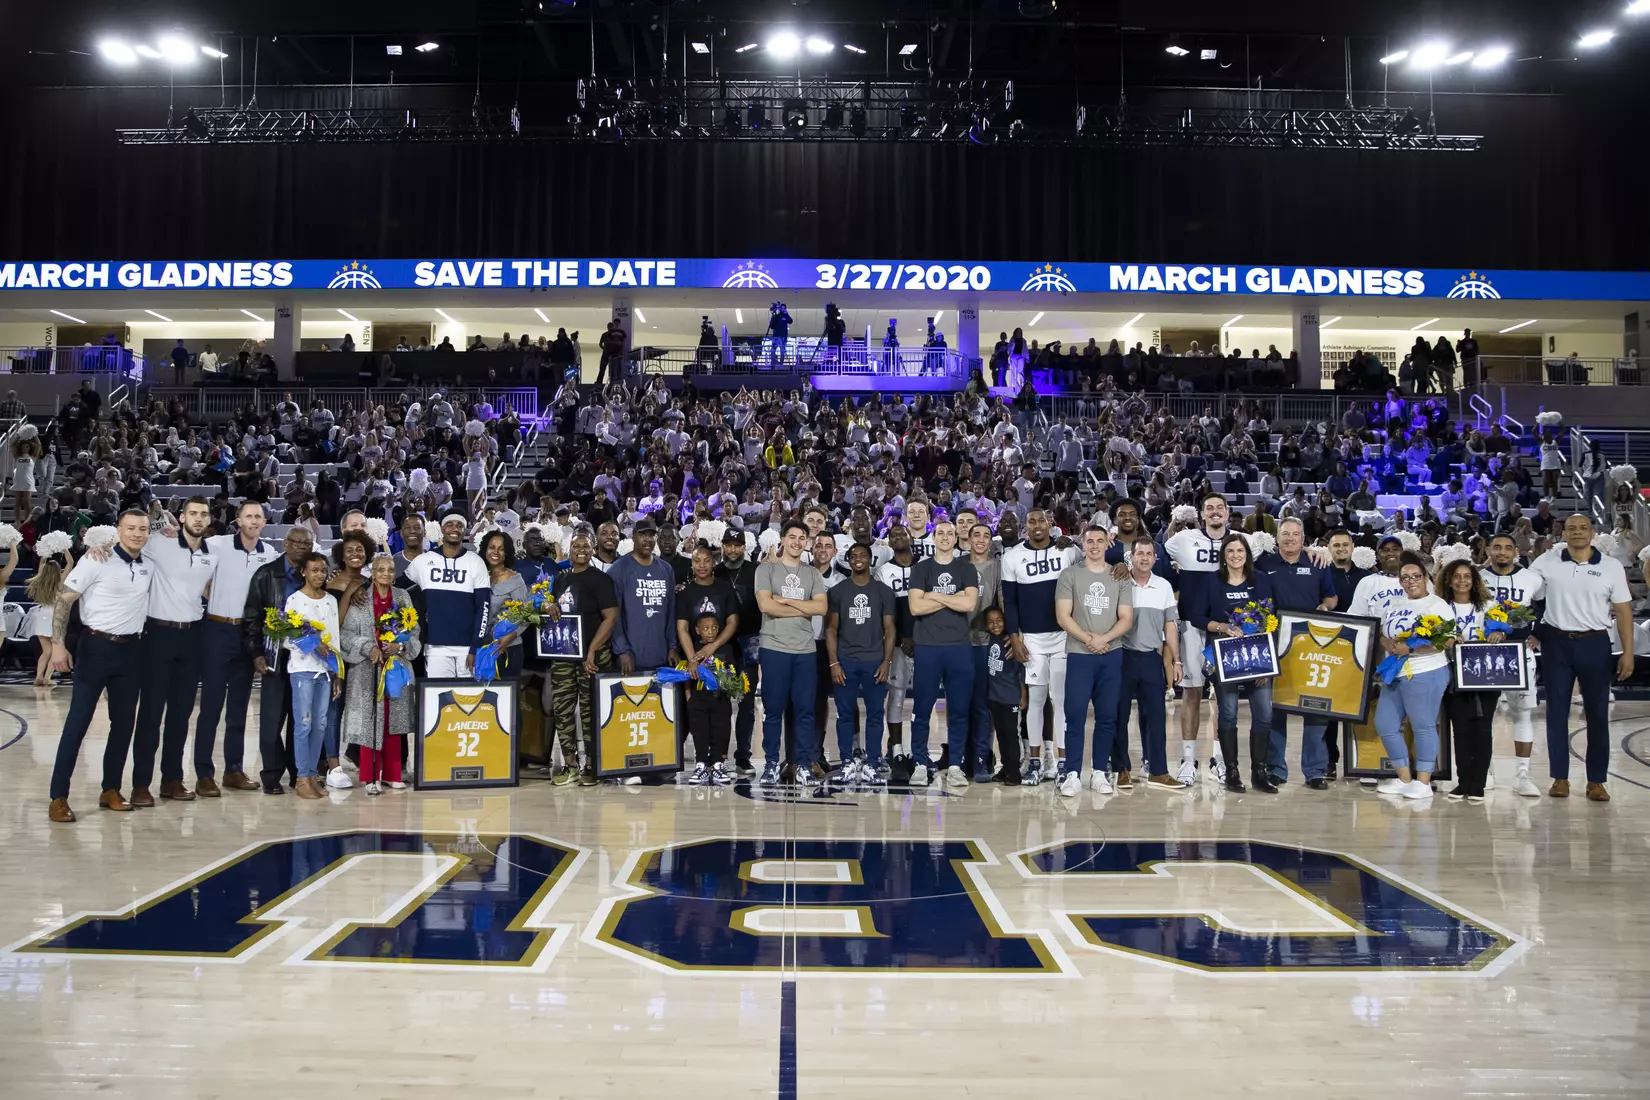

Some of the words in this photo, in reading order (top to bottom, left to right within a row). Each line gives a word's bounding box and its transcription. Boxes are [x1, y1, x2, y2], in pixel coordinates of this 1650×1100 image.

[118, 262, 293, 288] GLADNESS
[414, 261, 502, 286] SAVE
[512, 261, 578, 286] THE
[588, 261, 676, 286] DATE
[815, 263, 991, 291] 3/27/2020
[1109, 265, 1236, 292] MARCH
[1245, 268, 1425, 295] GLADNESS
[362, 325, 370, 345] MEN
[1197, 549, 1220, 563] CB
[430, 567, 467, 584] CBU
[1026, 557, 1061, 577] CBU
[636, 579, 666, 589] THREE
[636, 588, 666, 597] STRIPE
[642, 597, 663, 606] LIFE
[1371, 588, 1404, 603] TEAM
[478, 601, 490, 639] LANCERS
[1299, 652, 1343, 665] LANCERS
[1306, 663, 1331, 688] 33
[620, 710, 657, 722] LANCERS
[447, 721, 489, 732] LANCERS
[628, 722, 649, 747] 35
[455, 732, 480, 757] 32
[11, 827, 1531, 979] CBU
